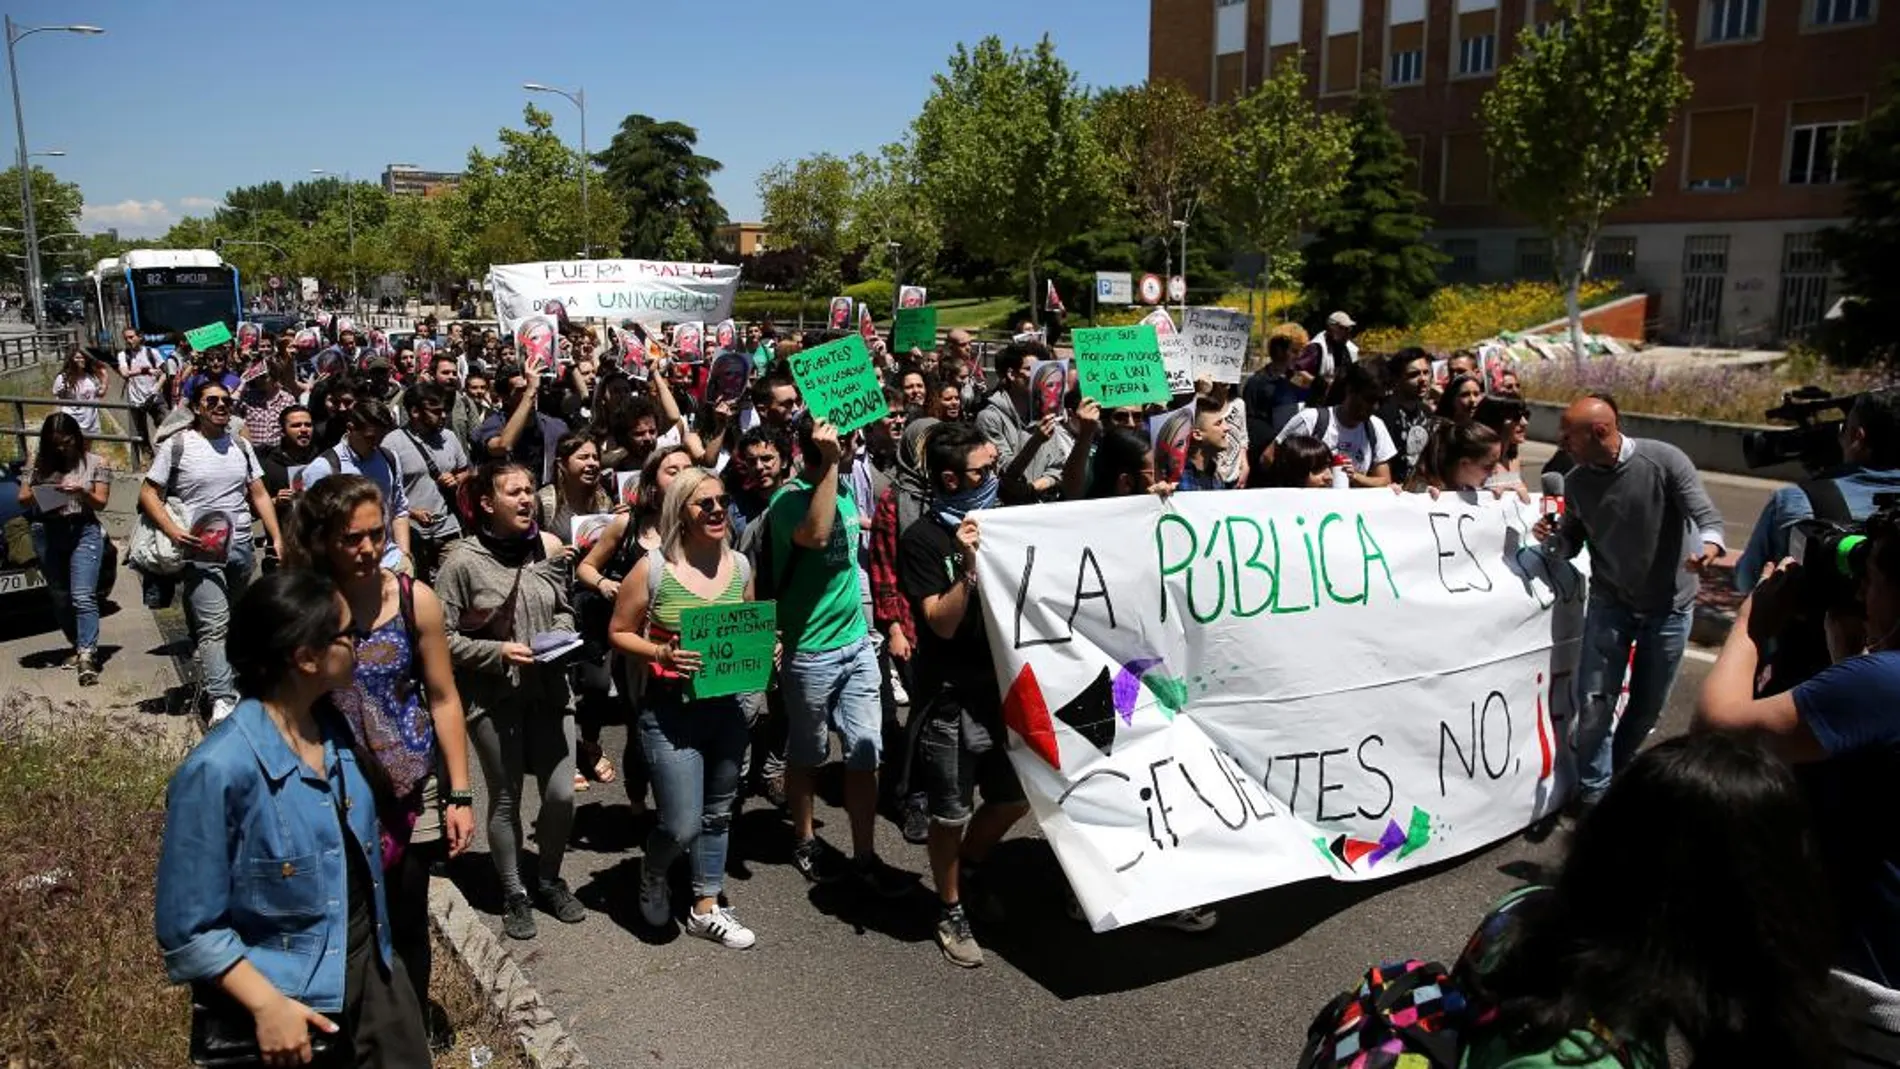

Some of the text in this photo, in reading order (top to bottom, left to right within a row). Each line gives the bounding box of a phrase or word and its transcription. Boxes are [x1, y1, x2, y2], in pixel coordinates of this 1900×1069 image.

[544, 262, 715, 279] FUERA MAFIA
[597, 290, 720, 313] UNIVERSIDAD
[793, 345, 852, 377] CIFUENTES
[1014, 545, 1116, 649] LA
[1428, 512, 1493, 593] ES
[708, 641, 735, 660] NO
